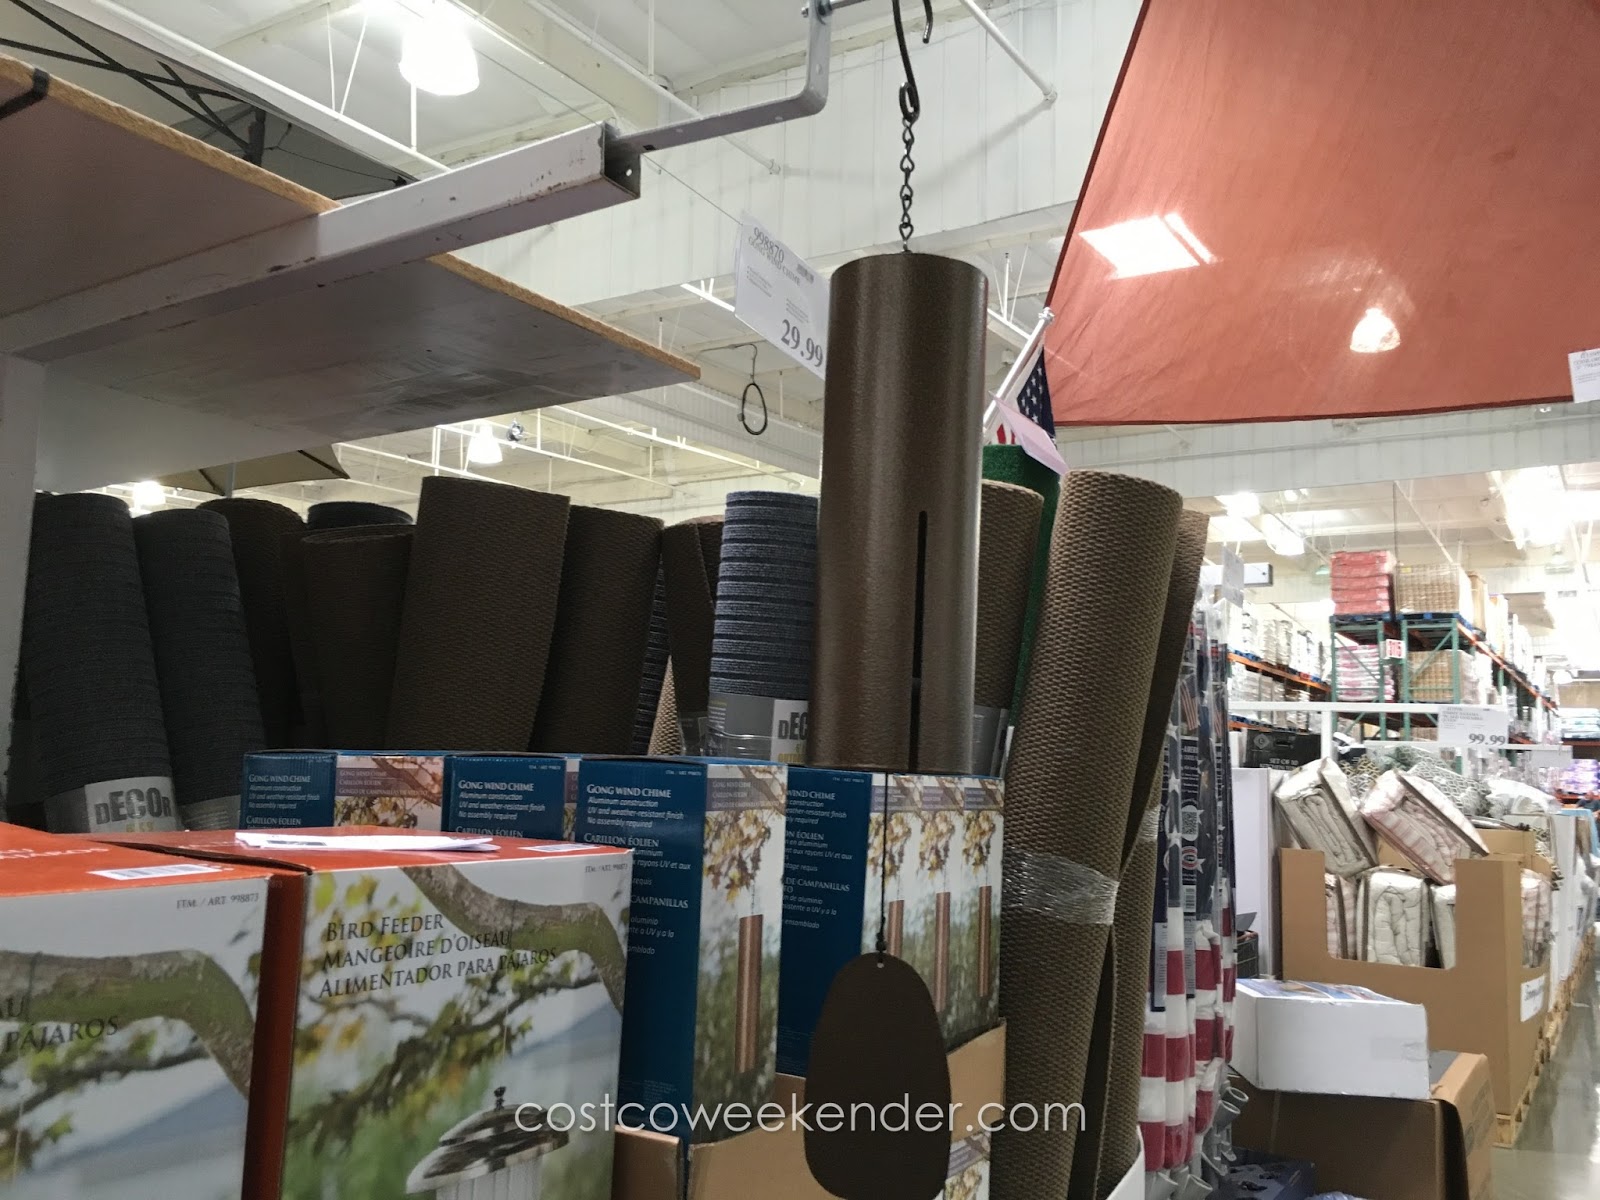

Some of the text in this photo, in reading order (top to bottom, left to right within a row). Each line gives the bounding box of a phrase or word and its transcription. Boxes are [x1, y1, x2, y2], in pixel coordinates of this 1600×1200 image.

[754, 226, 784, 263] 998870
[781, 319, 823, 367] 29.99
[778, 712, 808, 740] DEC
[1468, 733, 1506, 746] 99.99
[248, 774, 269, 782] GONG
[290, 775, 312, 783] CHIME
[458, 780, 535, 792] GONG WIND CHIME
[587, 784, 672, 798] GONG WIND CHIME
[809, 791, 836, 800] CHIME
[94, 787, 172, 824] DECOR
[620, 799, 659, 807] construction
[611, 808, 665, 819] weather-resistant
[665, 811, 684, 820] finish
[786, 808, 830, 817] eather-resistant
[597, 818, 624, 827] assembly
[625, 820, 653, 828] required
[584, 833, 627, 845] CARILLON
[786, 877, 796, 885] DE
[798, 878, 850, 892] CAMPANILLAS
[631, 895, 689, 908] CAMPANILLAS
[326, 914, 444, 942] BIRD FEEDER
[322, 930, 510, 973] MANGEOIRE D'OISEAU
[319, 963, 453, 998] ALIMENTADOR
[458, 958, 494, 976] PARA
